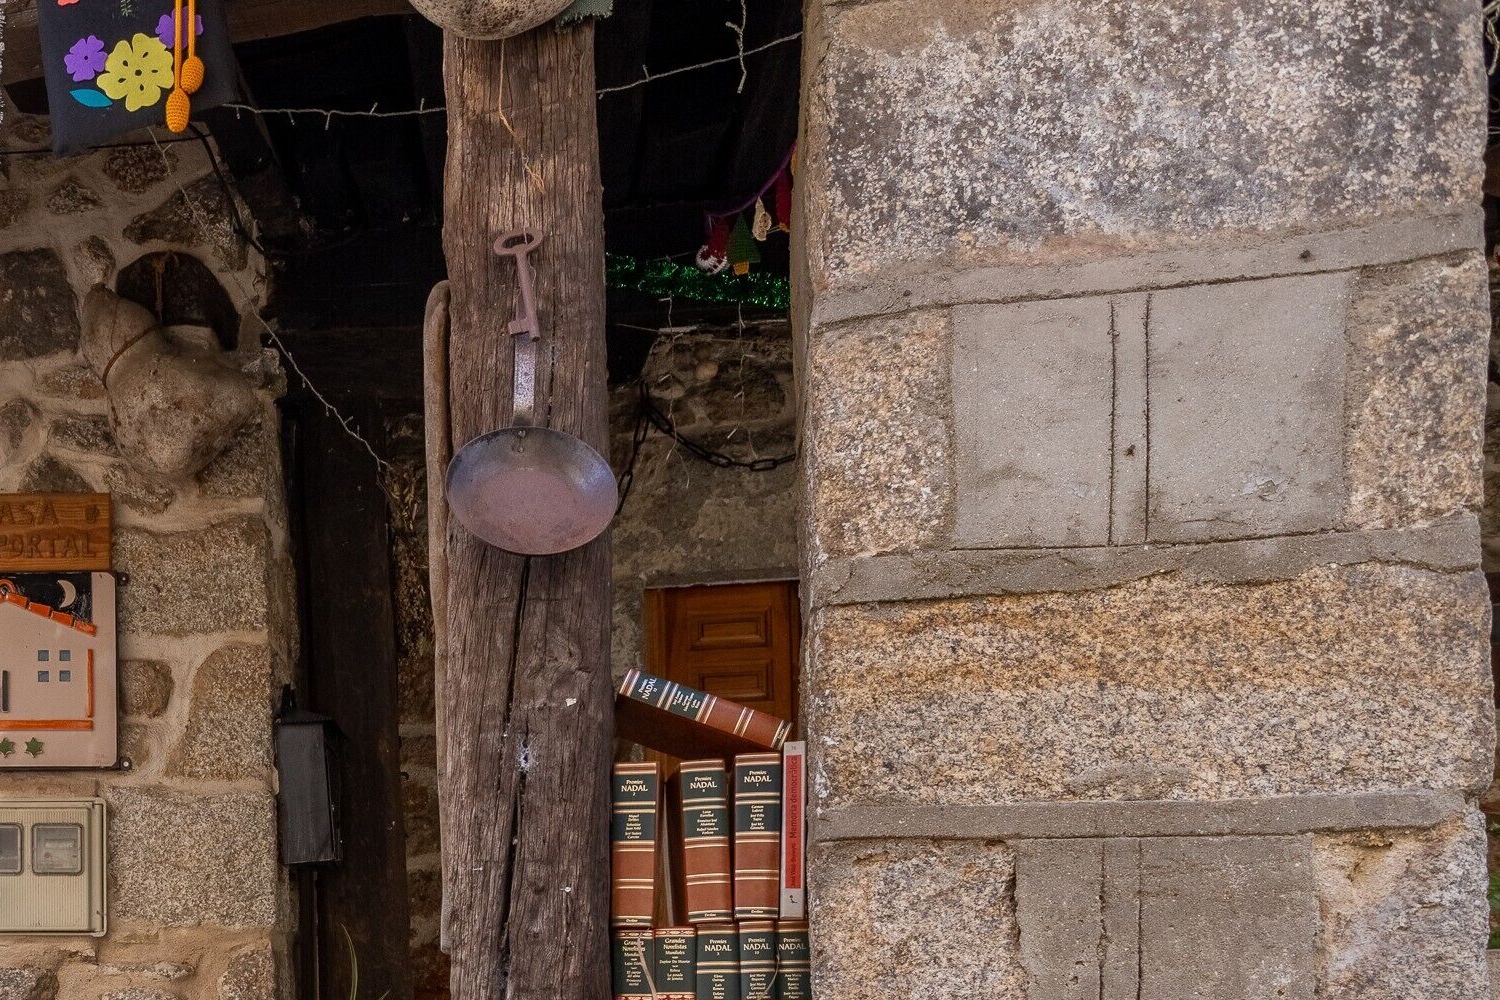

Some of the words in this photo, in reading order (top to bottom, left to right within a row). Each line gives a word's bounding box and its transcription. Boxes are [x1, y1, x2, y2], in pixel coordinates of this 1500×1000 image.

[641, 677, 657, 700] NADAL
[743, 775, 772, 784] NADAL
[621, 784, 649, 793] NADAL
[689, 780, 718, 790] NADAL
[789, 805, 798, 839] Memoria
[704, 944, 733, 952] NADAL
[743, 943, 772, 951] NADAL
[778, 943, 806, 951] NADAL
